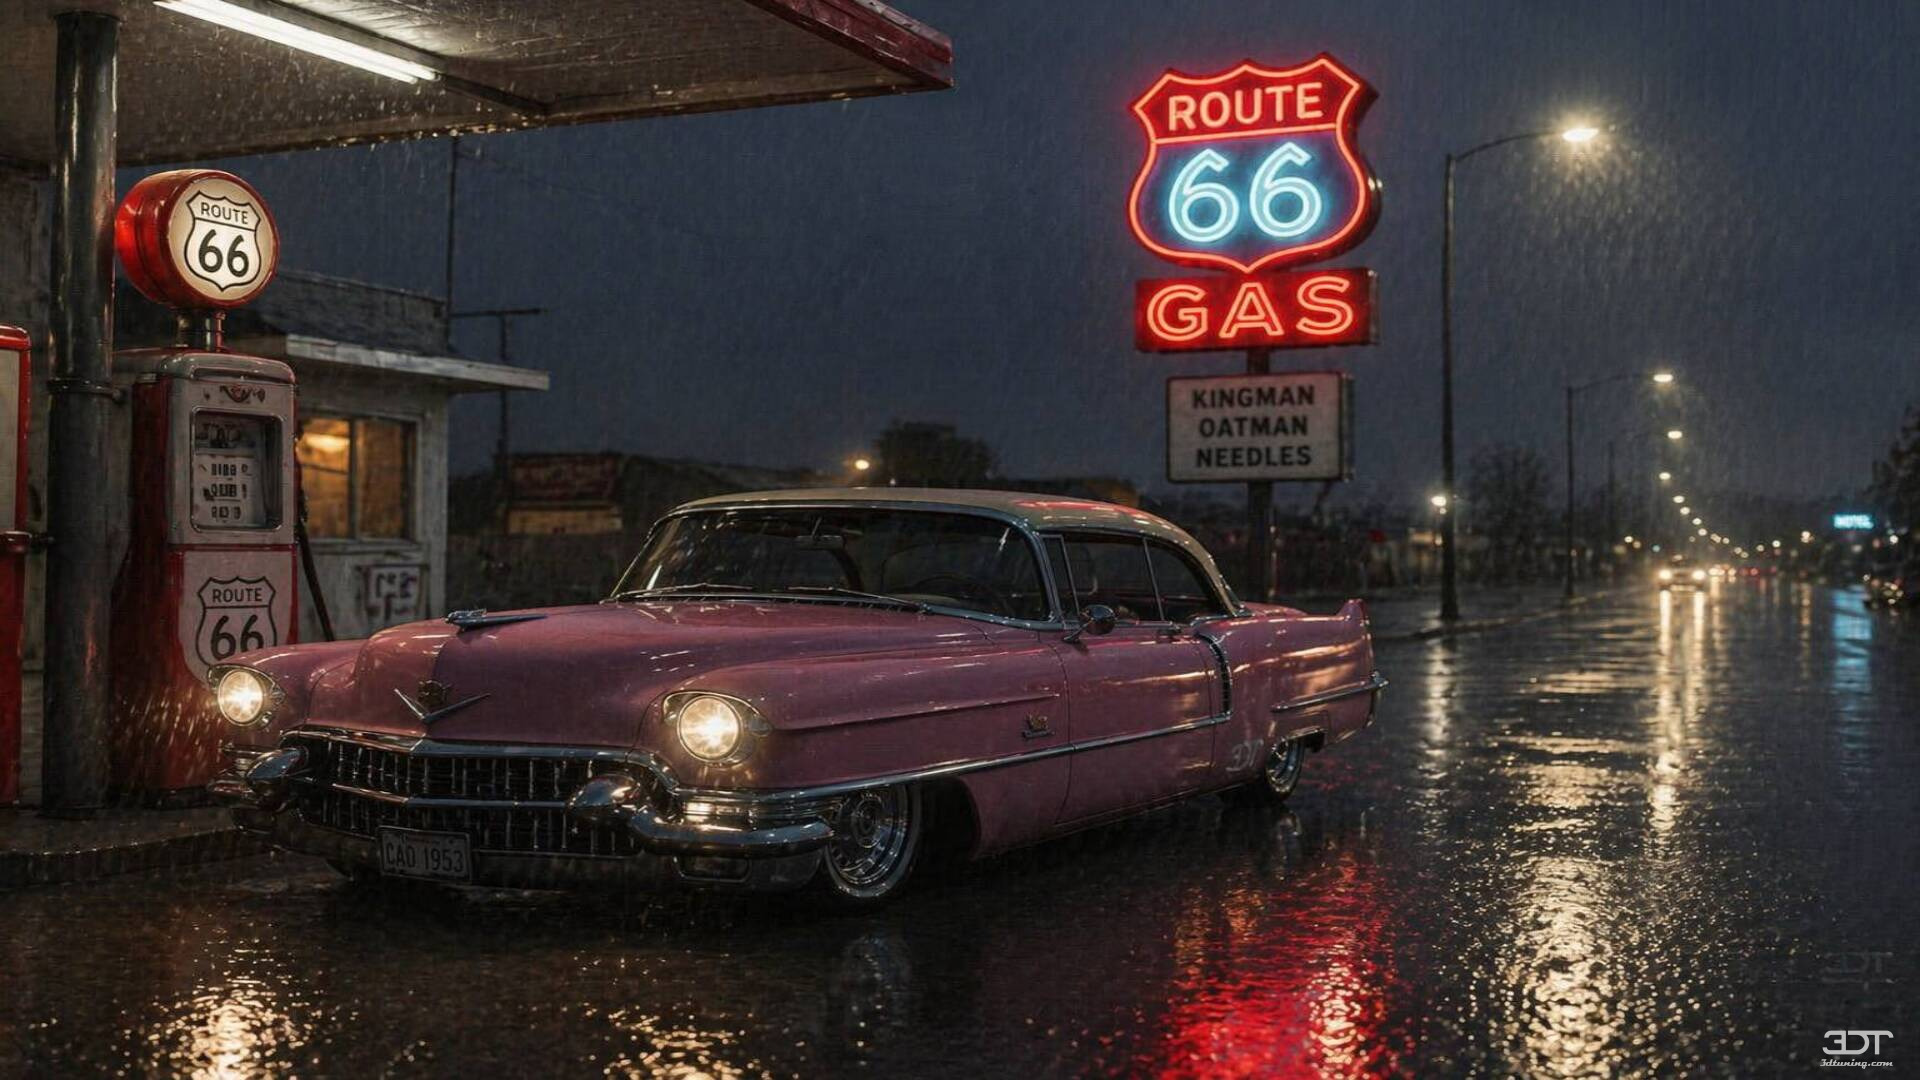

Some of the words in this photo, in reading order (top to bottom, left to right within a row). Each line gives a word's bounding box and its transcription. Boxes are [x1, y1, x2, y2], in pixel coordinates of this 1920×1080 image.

[1167, 82, 1324, 131] ROUTE
[1168, 141, 1323, 243] 66
[200, 201, 249, 225] ROUTE
[198, 228, 250, 278] 66
[1146, 275, 1354, 342] GAS
[1192, 385, 1315, 409] KINGMAN
[1199, 416, 1309, 438] OATMAN
[1196, 446, 1313, 468] NEEDLES
[212, 588, 263, 603] ROUTE
[210, 614, 265, 662] 66
[423, 846, 464, 873] 1953
